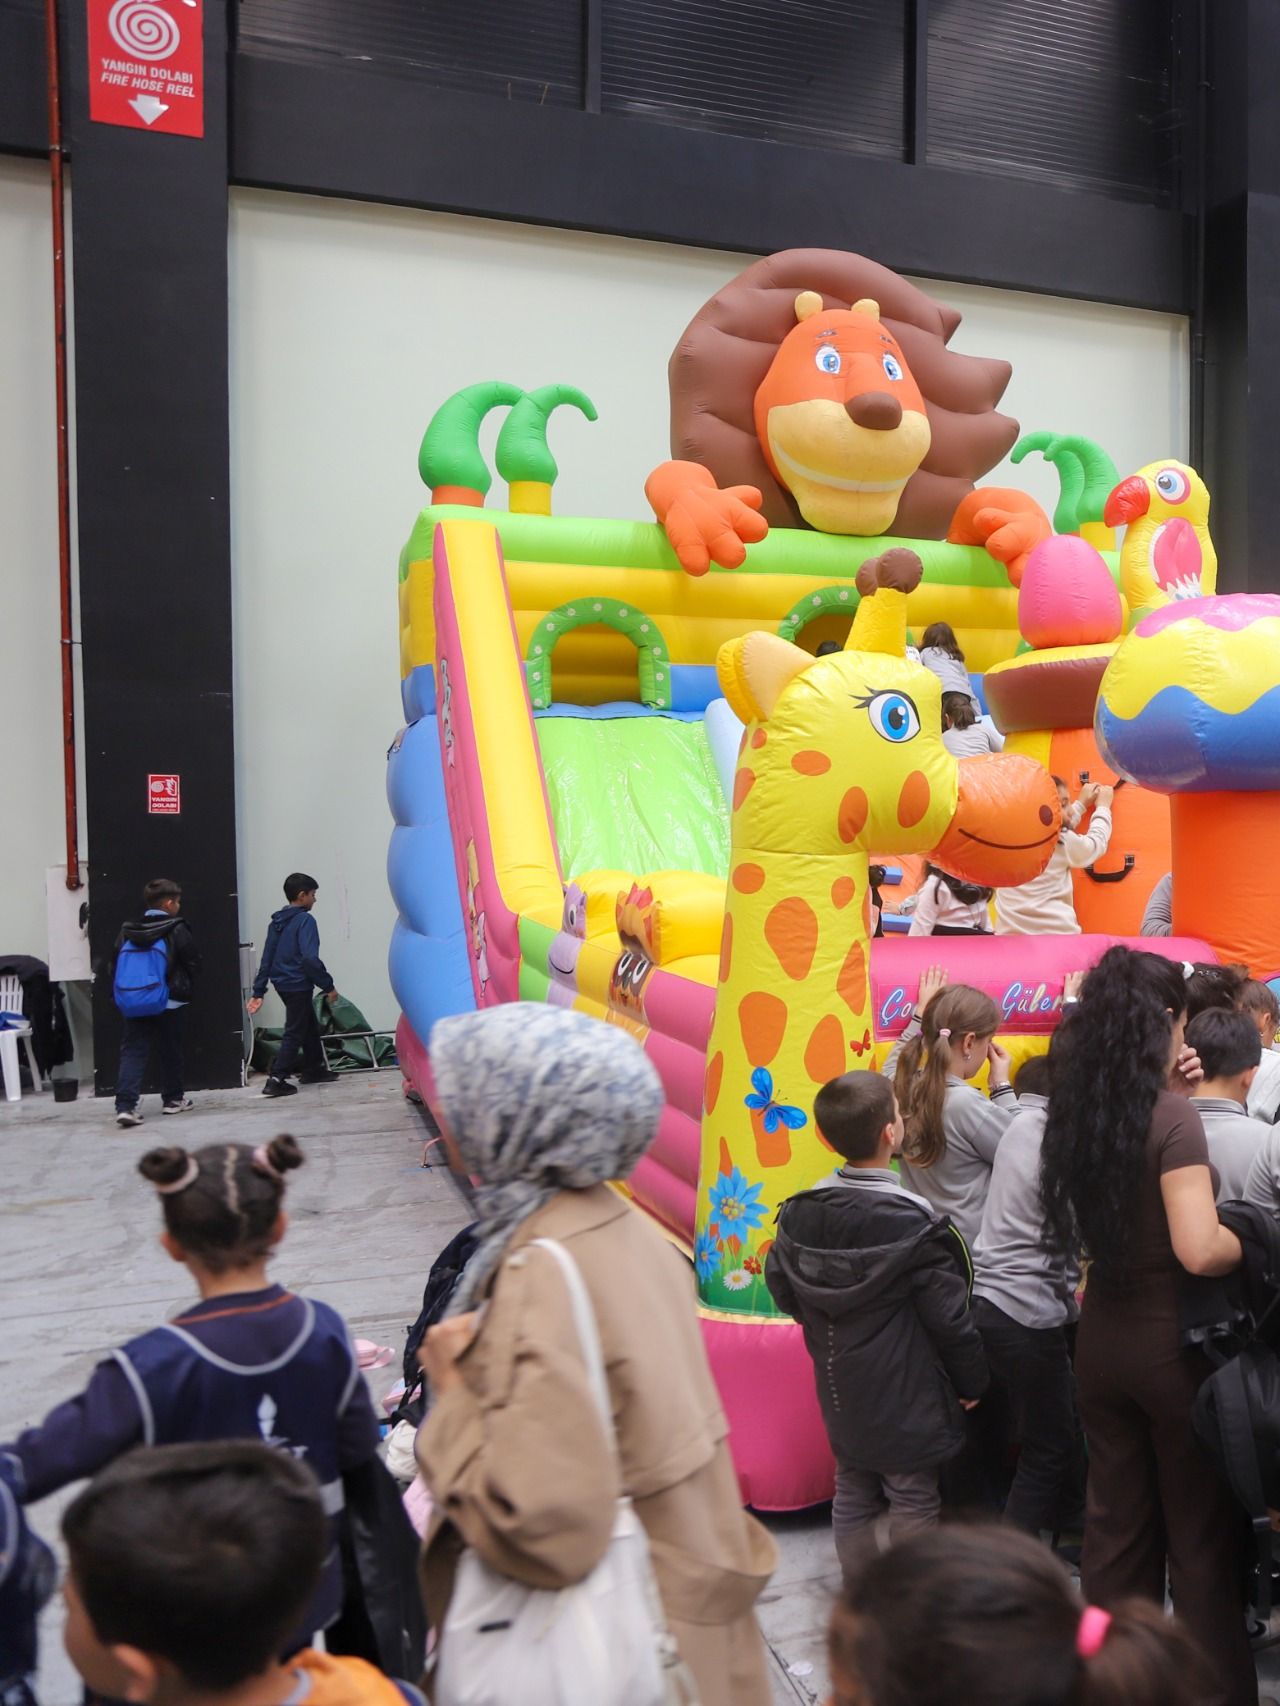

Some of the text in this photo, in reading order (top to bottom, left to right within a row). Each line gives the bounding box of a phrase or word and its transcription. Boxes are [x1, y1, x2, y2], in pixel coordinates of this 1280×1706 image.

[101, 58, 194, 84] YANGIN DOLABI
[101, 72, 196, 98] FIRE HOSE REEL
[880, 988, 914, 1027] Ço
